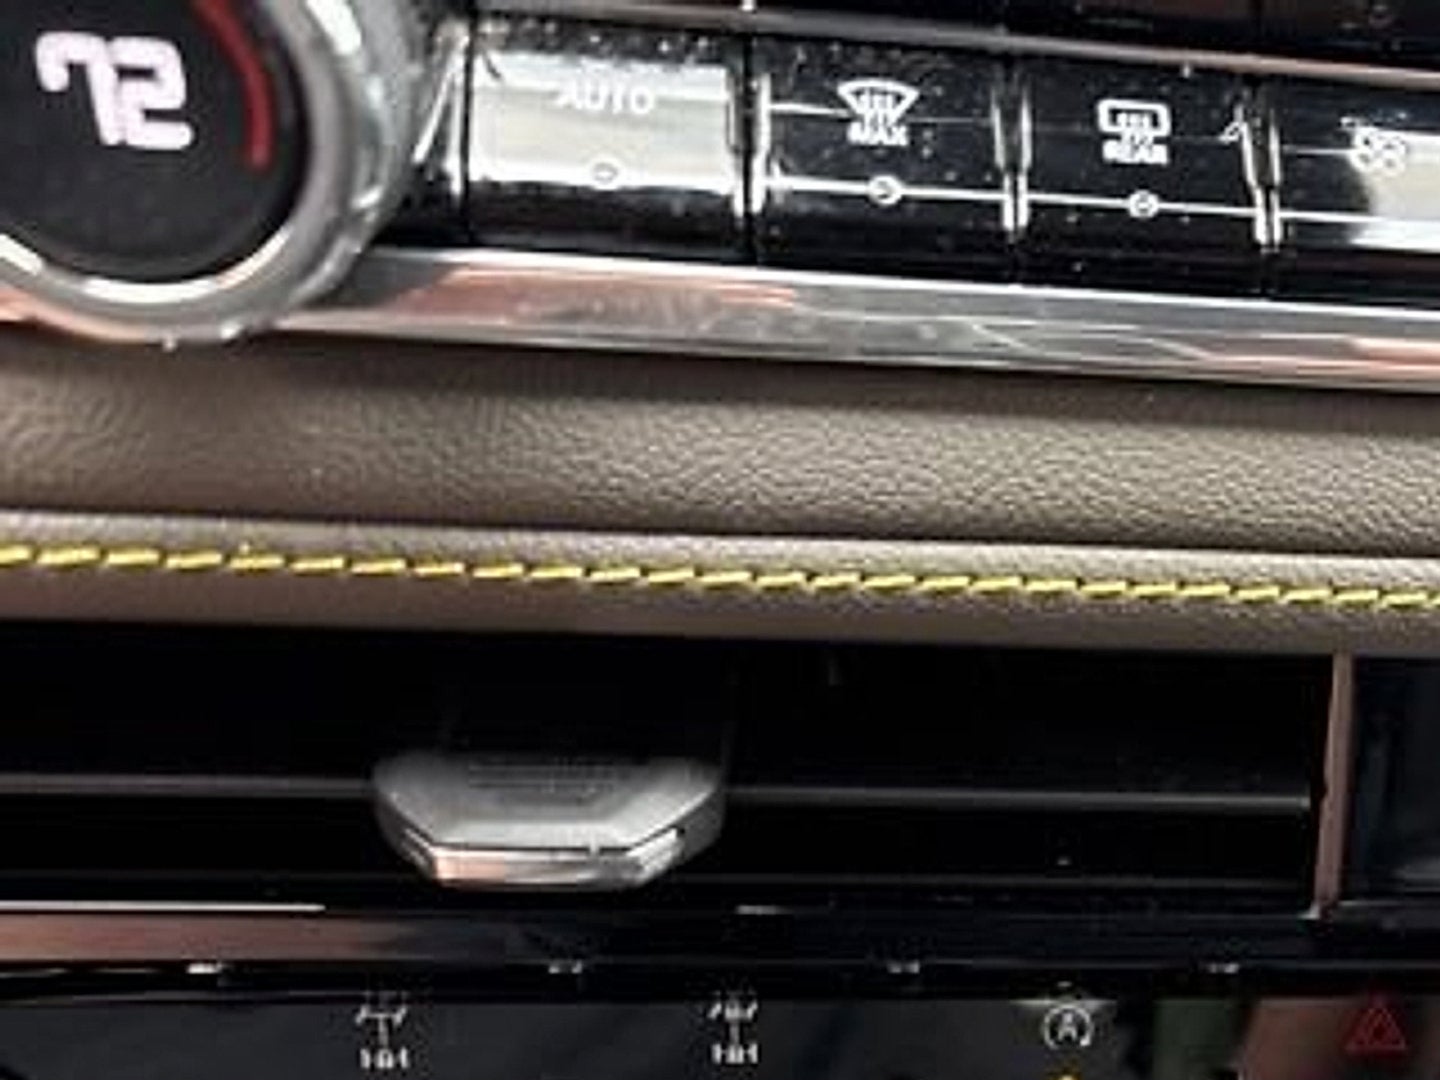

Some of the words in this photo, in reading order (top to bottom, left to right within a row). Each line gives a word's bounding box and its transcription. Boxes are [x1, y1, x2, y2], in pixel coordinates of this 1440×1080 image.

[36, 31, 192, 150] 72
[555, 81, 656, 116] AUTO
[1102, 140, 1169, 165] REAR
